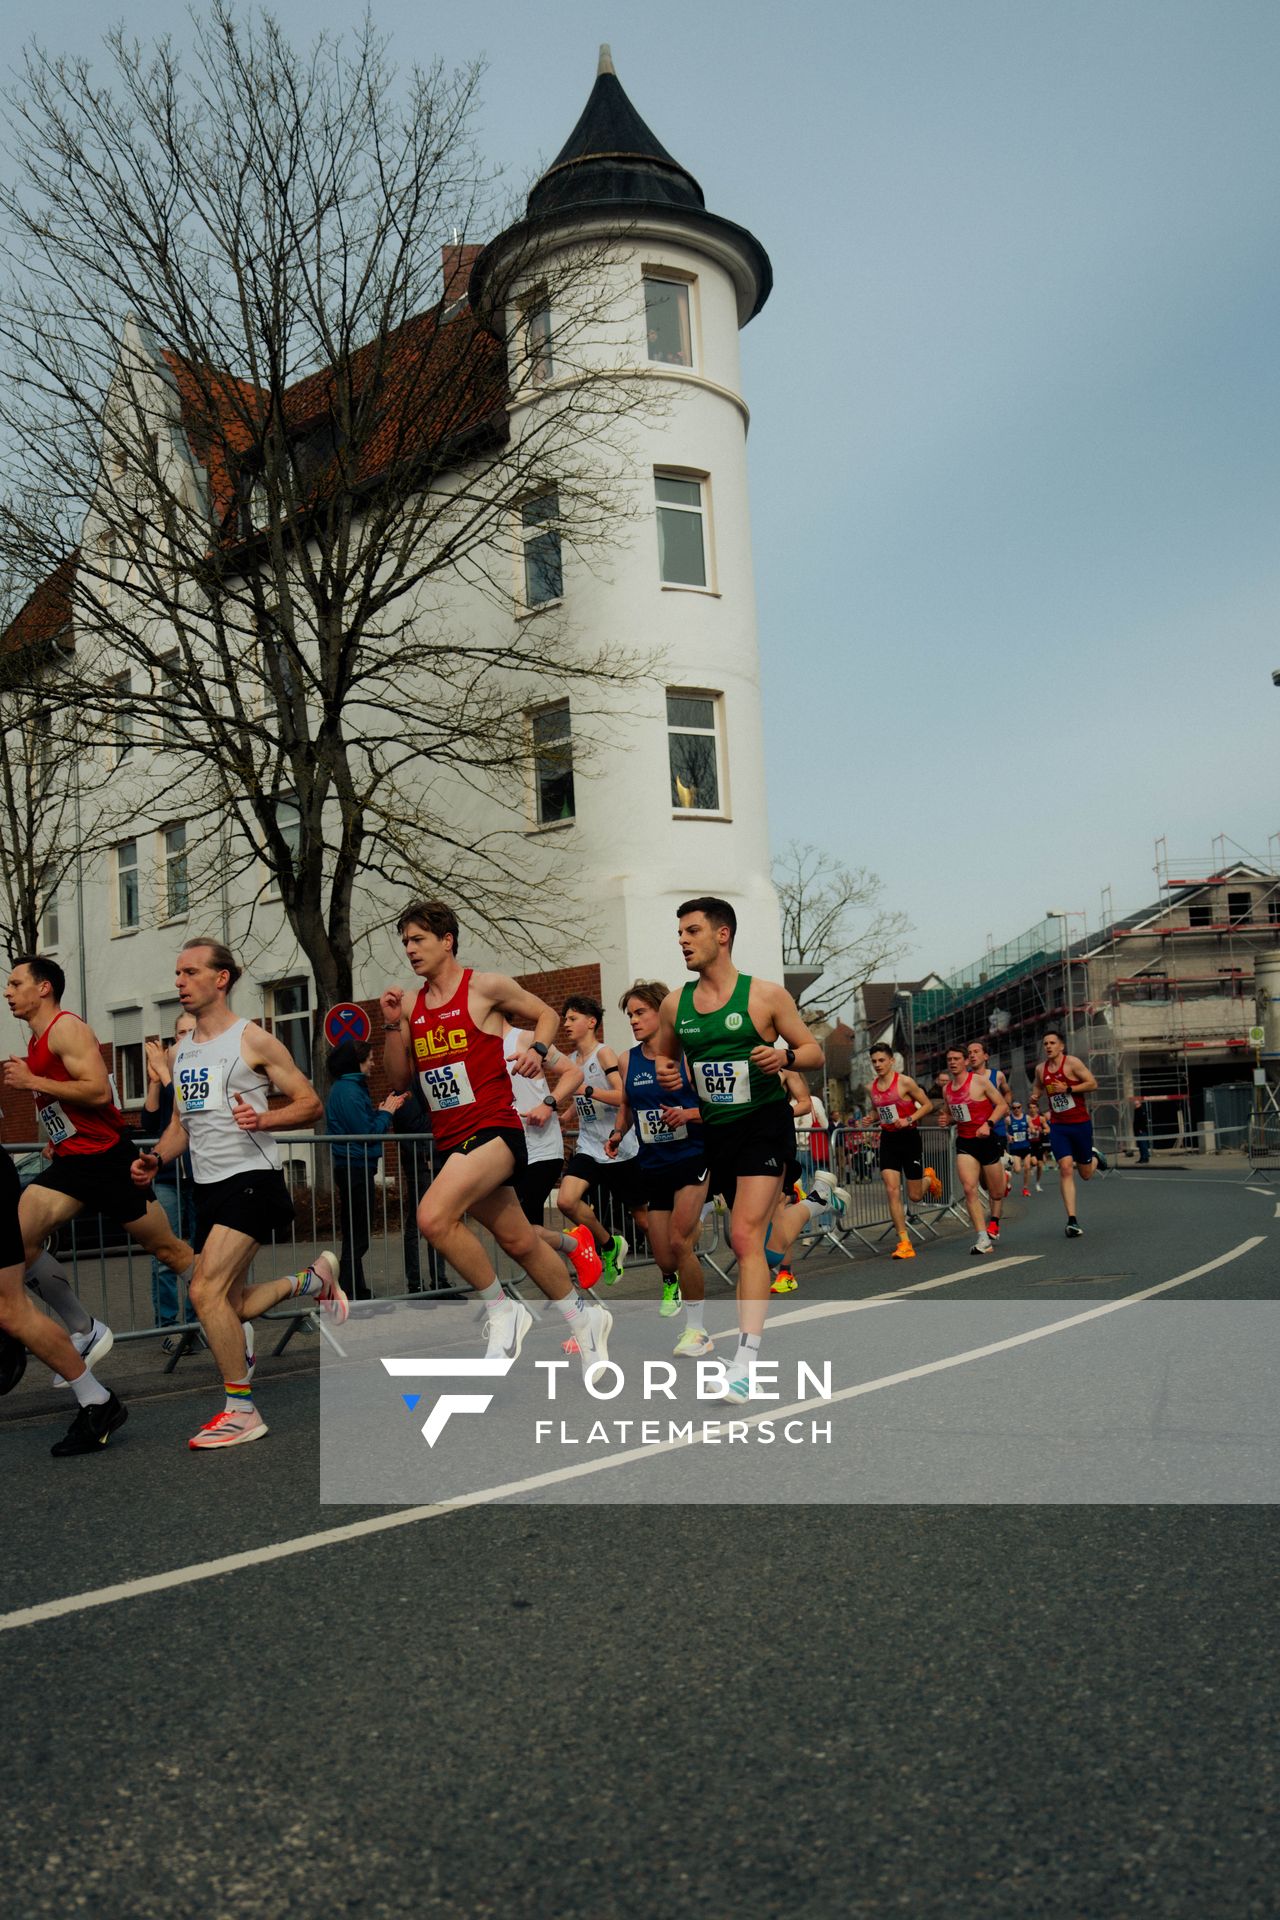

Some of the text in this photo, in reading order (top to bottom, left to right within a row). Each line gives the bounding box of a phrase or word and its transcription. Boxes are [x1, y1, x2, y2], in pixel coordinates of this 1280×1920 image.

[414, 1028, 468, 1058] BLC
[179, 1067, 209, 1084] GLS
[424, 1066, 454, 1085] GLS
[701, 1062, 734, 1077] GLS
[181, 1082, 210, 1101] 329
[431, 1079, 460, 1100] 424
[705, 1077, 736, 1093] 647
[576, 1097, 592, 1106] GLS
[41, 1106, 57, 1122] GLS
[45, 1116, 65, 1136] 310
